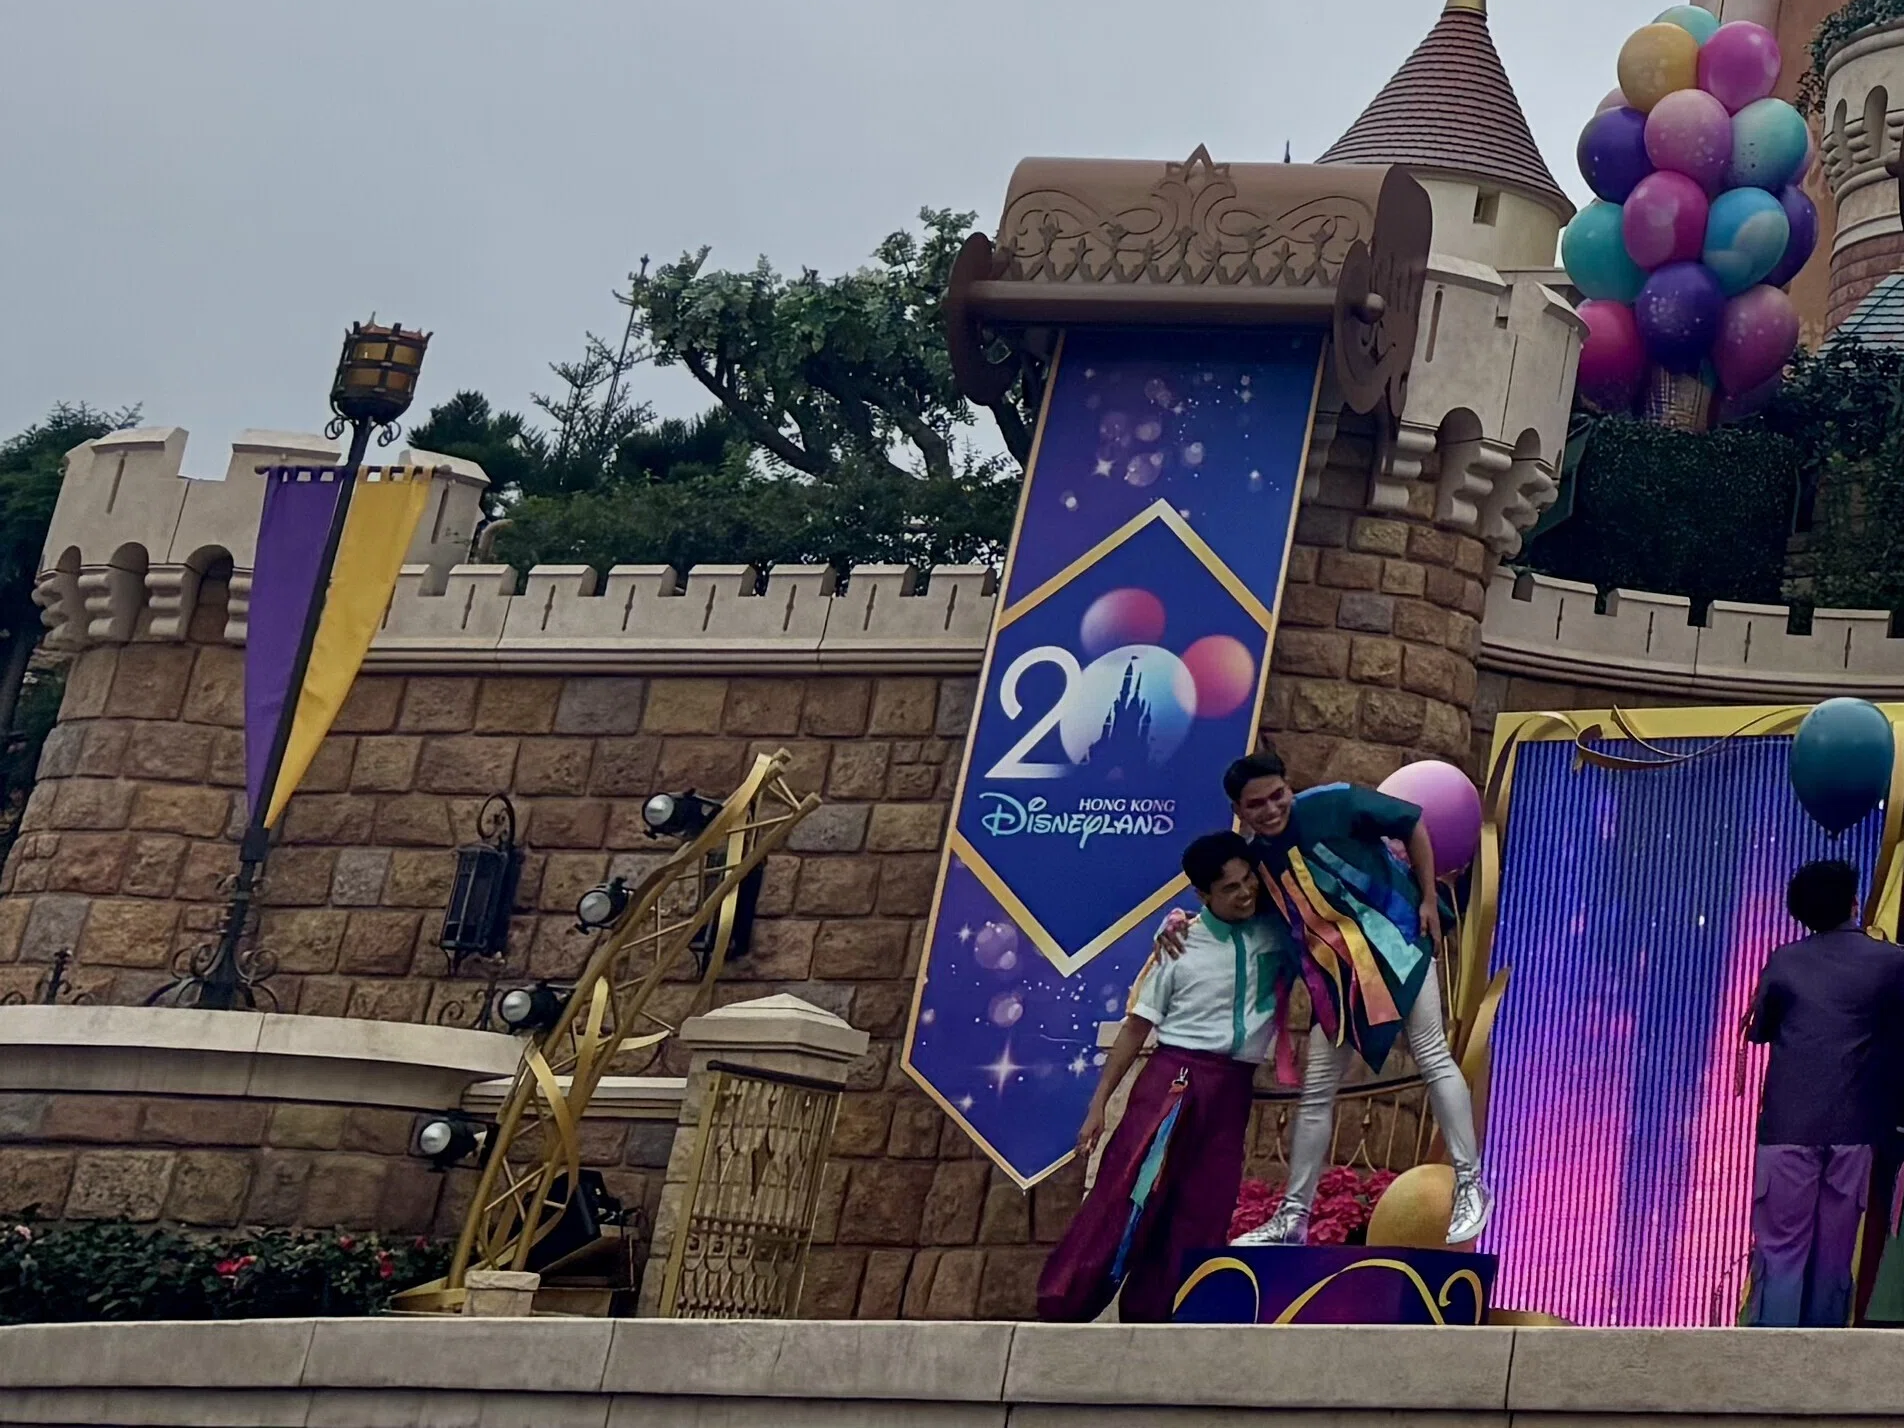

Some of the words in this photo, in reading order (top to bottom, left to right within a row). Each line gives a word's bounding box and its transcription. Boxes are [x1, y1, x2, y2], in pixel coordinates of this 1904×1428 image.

[984, 644, 1197, 779] 20
[1078, 798, 1126, 813] HONG
[1130, 798, 1176, 813] KONG
